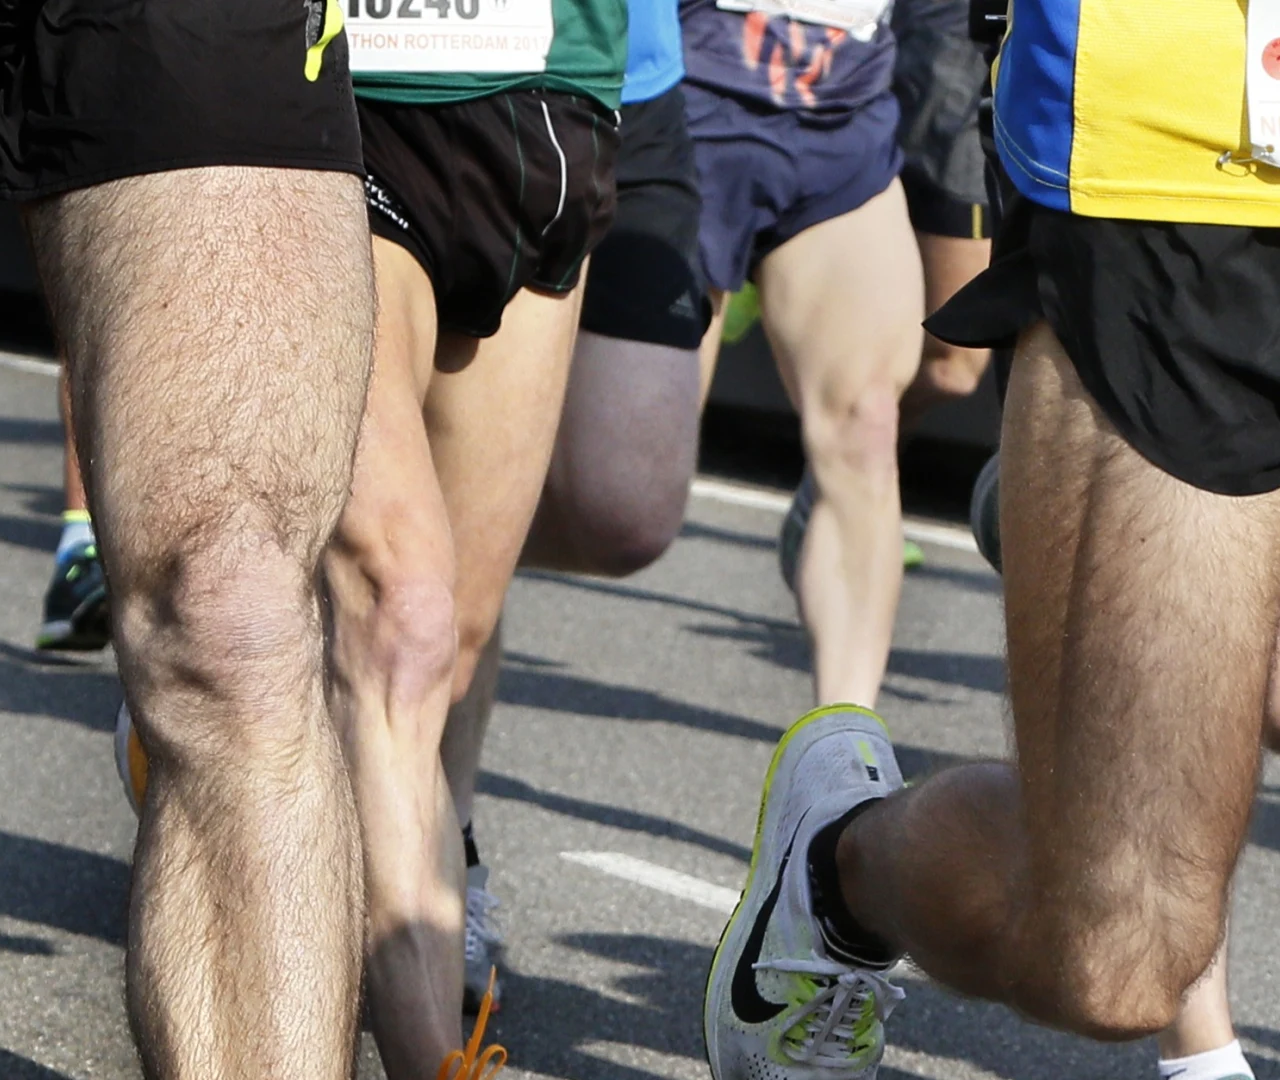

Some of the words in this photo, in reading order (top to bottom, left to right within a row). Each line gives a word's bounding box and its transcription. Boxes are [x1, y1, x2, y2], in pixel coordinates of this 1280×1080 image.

[350, 33, 398, 50] THON
[404, 34, 508, 51] ROTTERDAM
[514, 36, 548, 51] 2017
